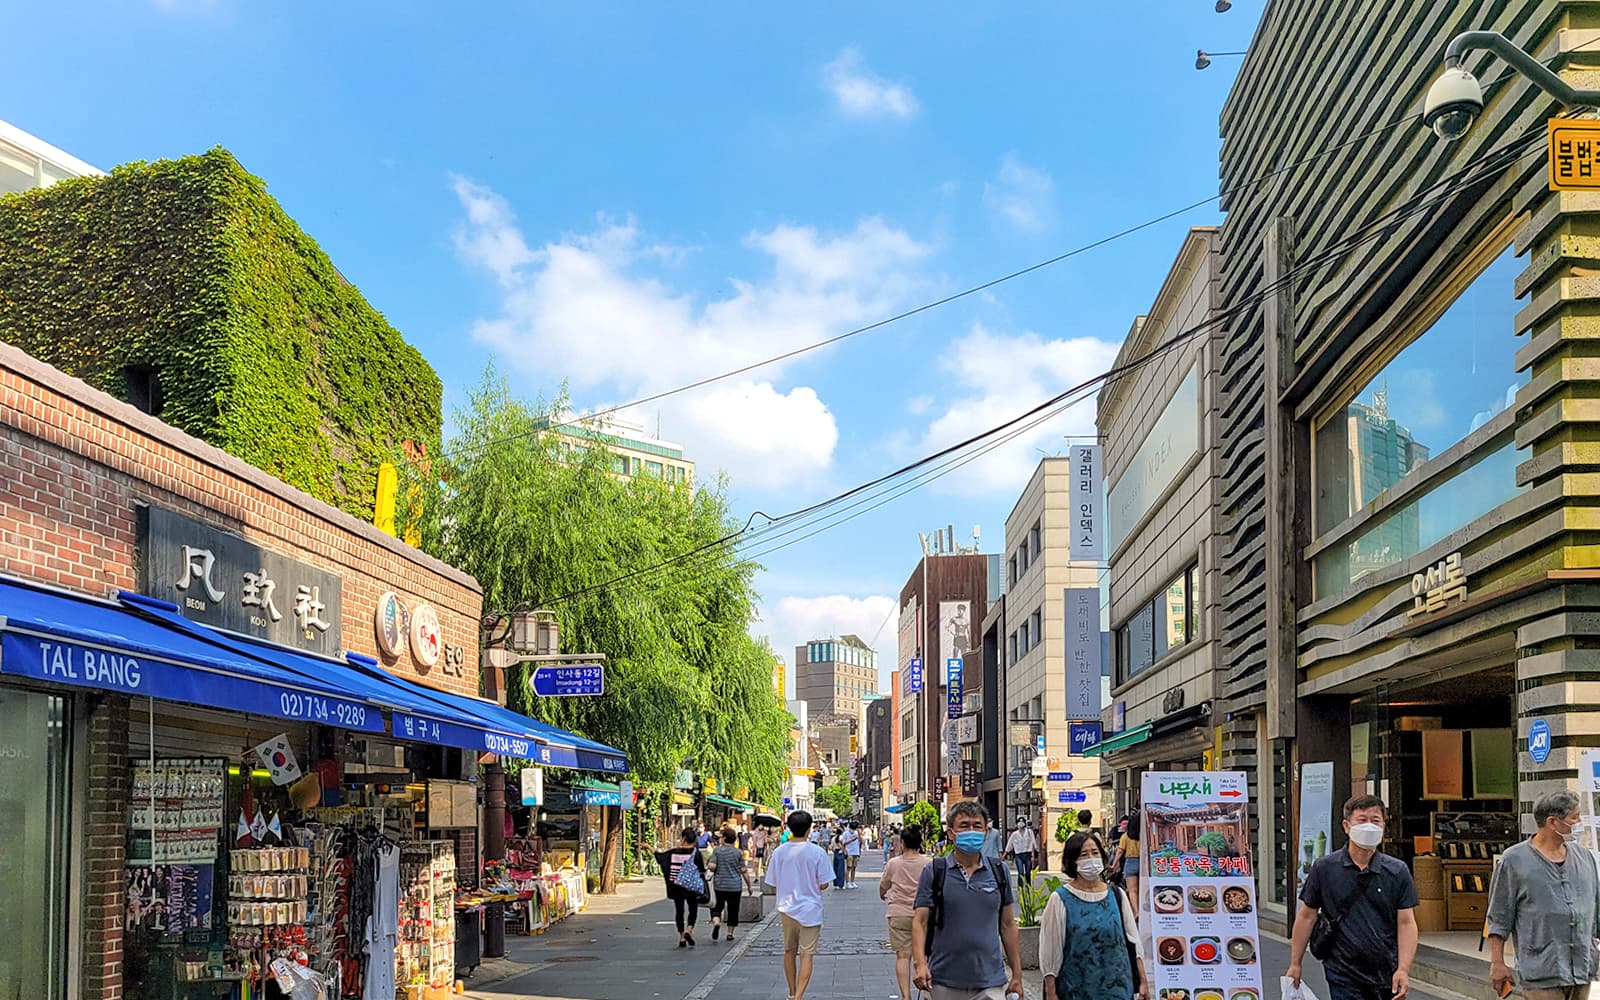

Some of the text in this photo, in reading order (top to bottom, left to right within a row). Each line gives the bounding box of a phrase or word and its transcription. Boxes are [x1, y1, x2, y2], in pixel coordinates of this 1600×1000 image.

[1080, 448, 1093, 547] 갤러리 인덱스
[1407, 552, 1467, 617] 오설록
[186, 597, 315, 641] BEOM KOO SA
[40, 643, 141, 688] TAL BANG
[1154, 856, 1248, 873] 전통한옥 카페
